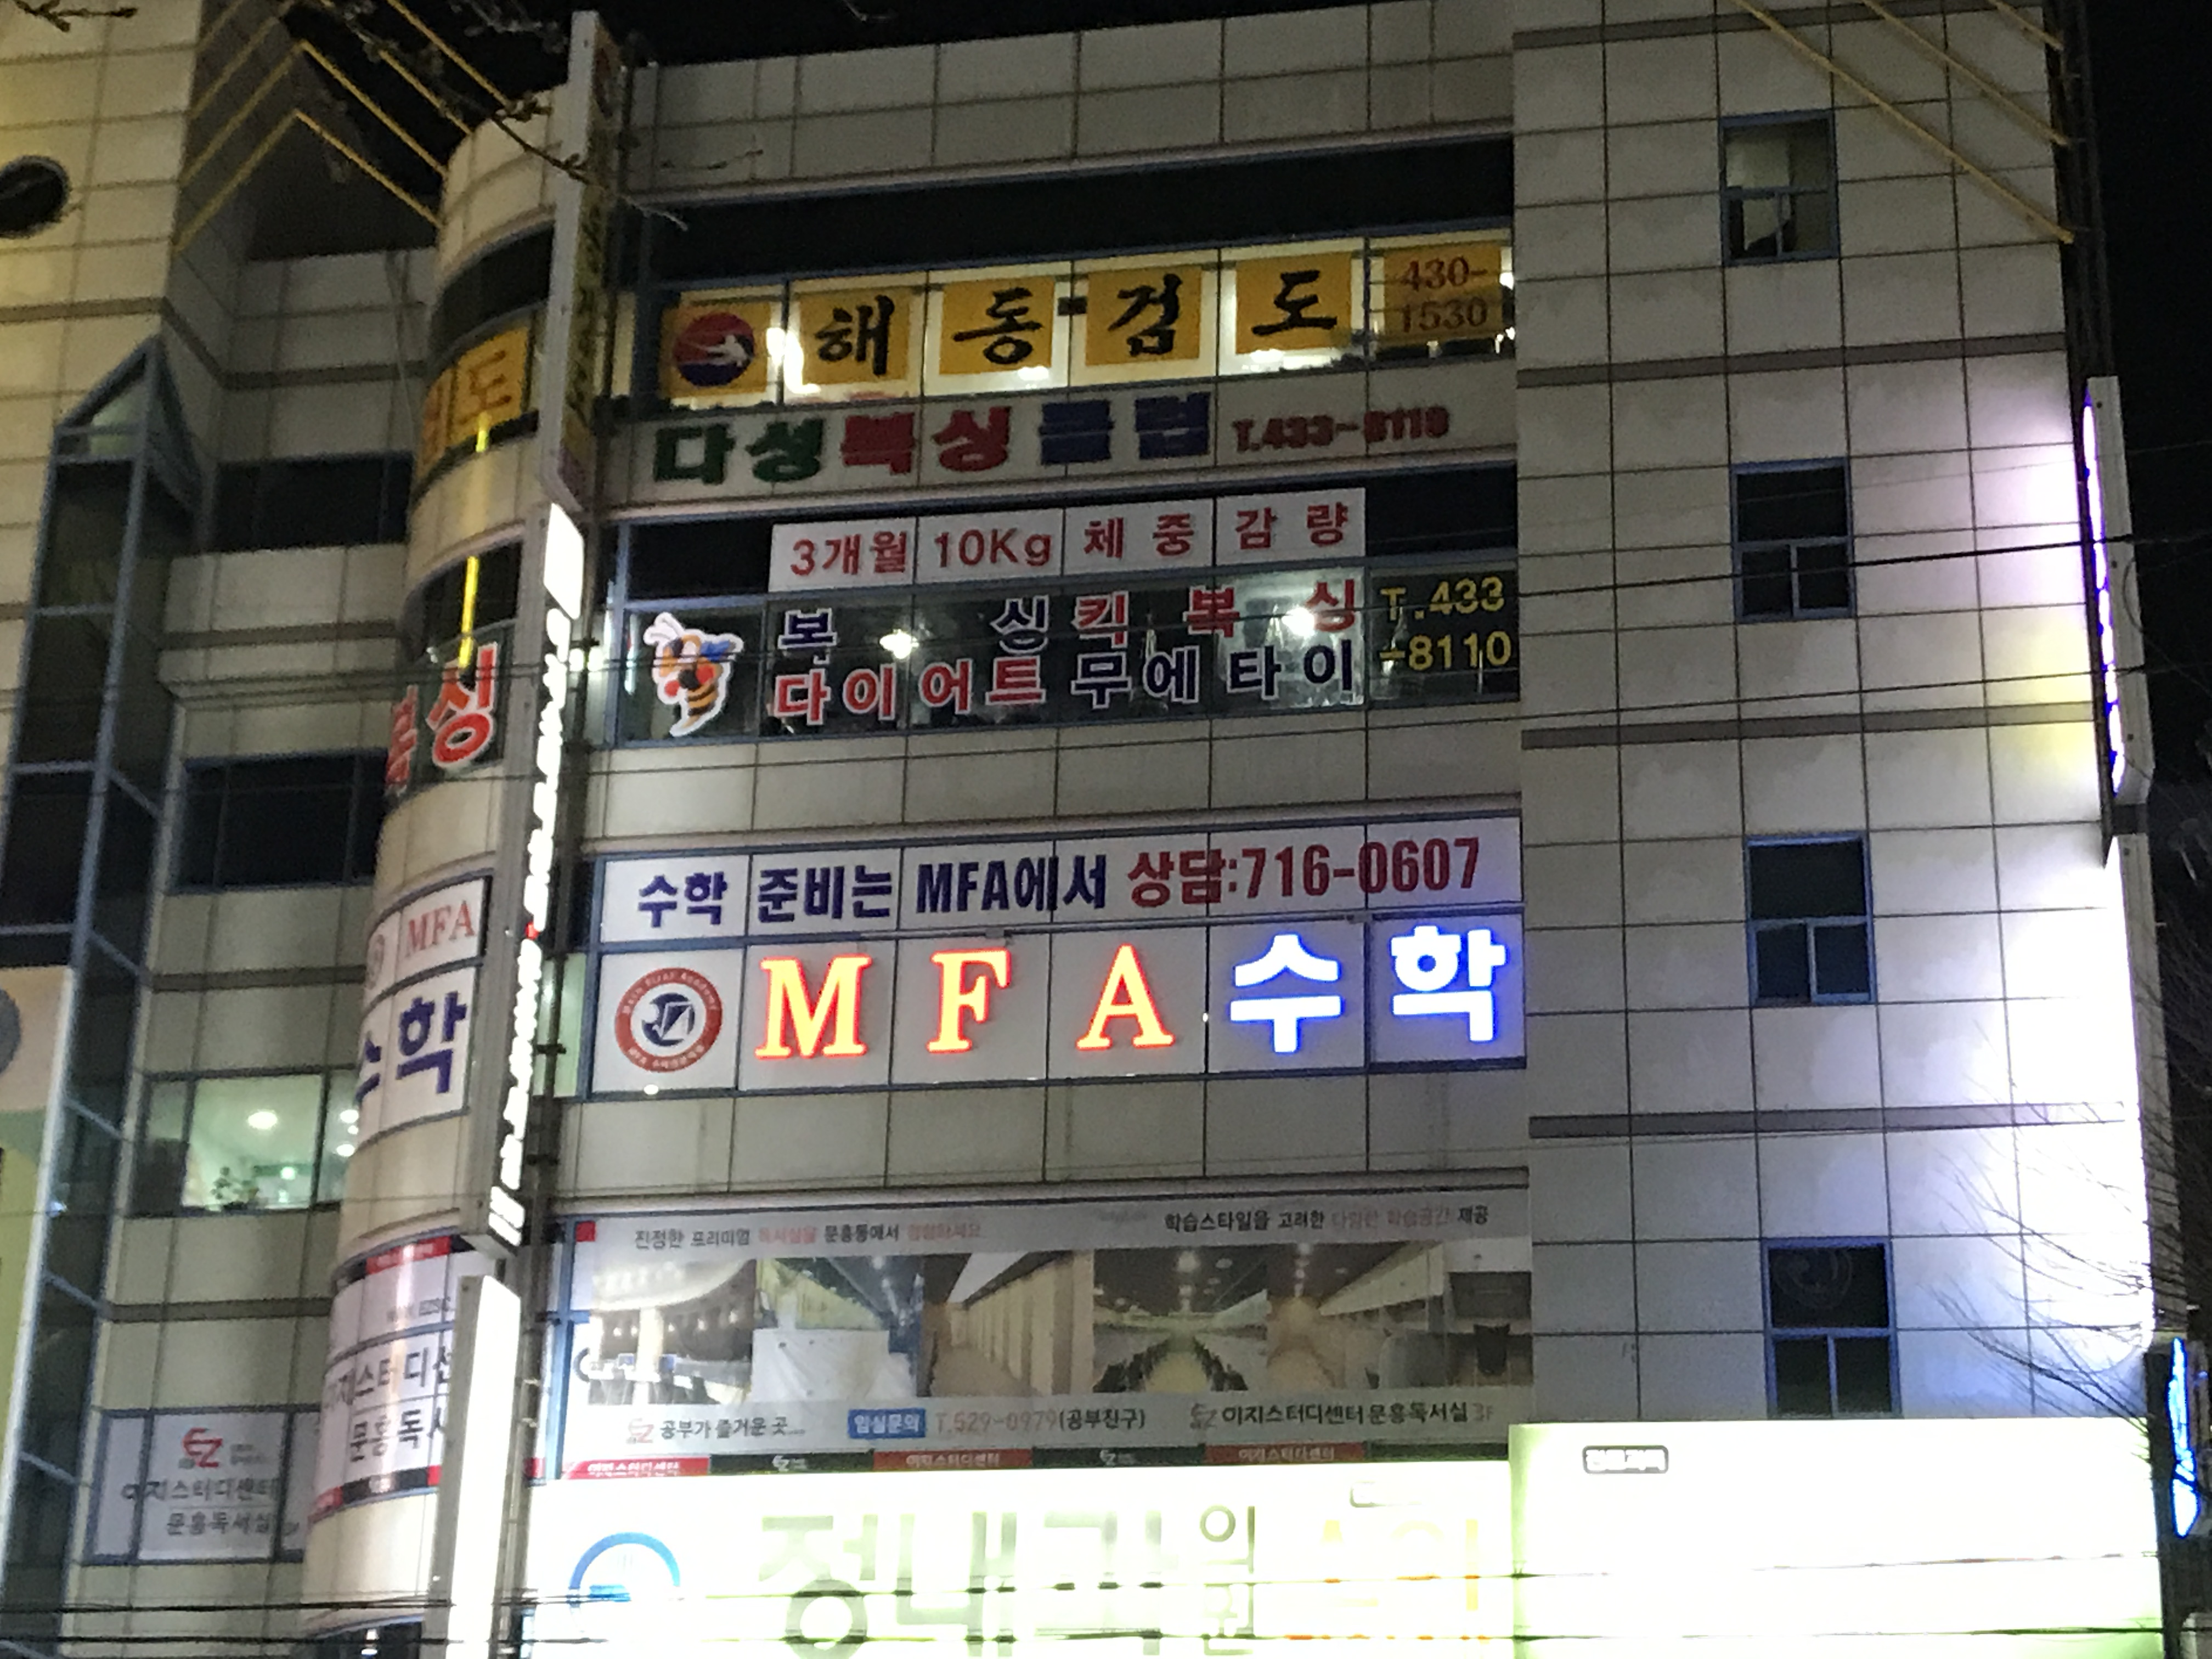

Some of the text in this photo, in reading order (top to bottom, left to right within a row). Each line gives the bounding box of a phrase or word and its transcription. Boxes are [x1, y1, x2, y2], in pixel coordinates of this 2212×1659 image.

[1400, 256, 1488, 291] 430-
[815, 269, 1338, 375] 해동검도
[1402, 297, 1488, 333] 1530
[790, 501, 1349, 577] 3개월 10Kg 체중 감량
[1380, 576, 1504, 621] T.433
[1379, 631, 1511, 670] -8110
[774, 639, 1353, 725] 다이어트 무에타이
[638, 837, 1480, 928] 수학 준비는 MFA에서 상담:716-0607
[405, 900, 476, 957] MFA
[754, 924, 1508, 1060] MFA 수학
[635, 1228, 685, 1250] 진정한
[659, 1419, 712, 1440] 공부가
[1222, 1404, 1363, 1425] 이지스터디센터
